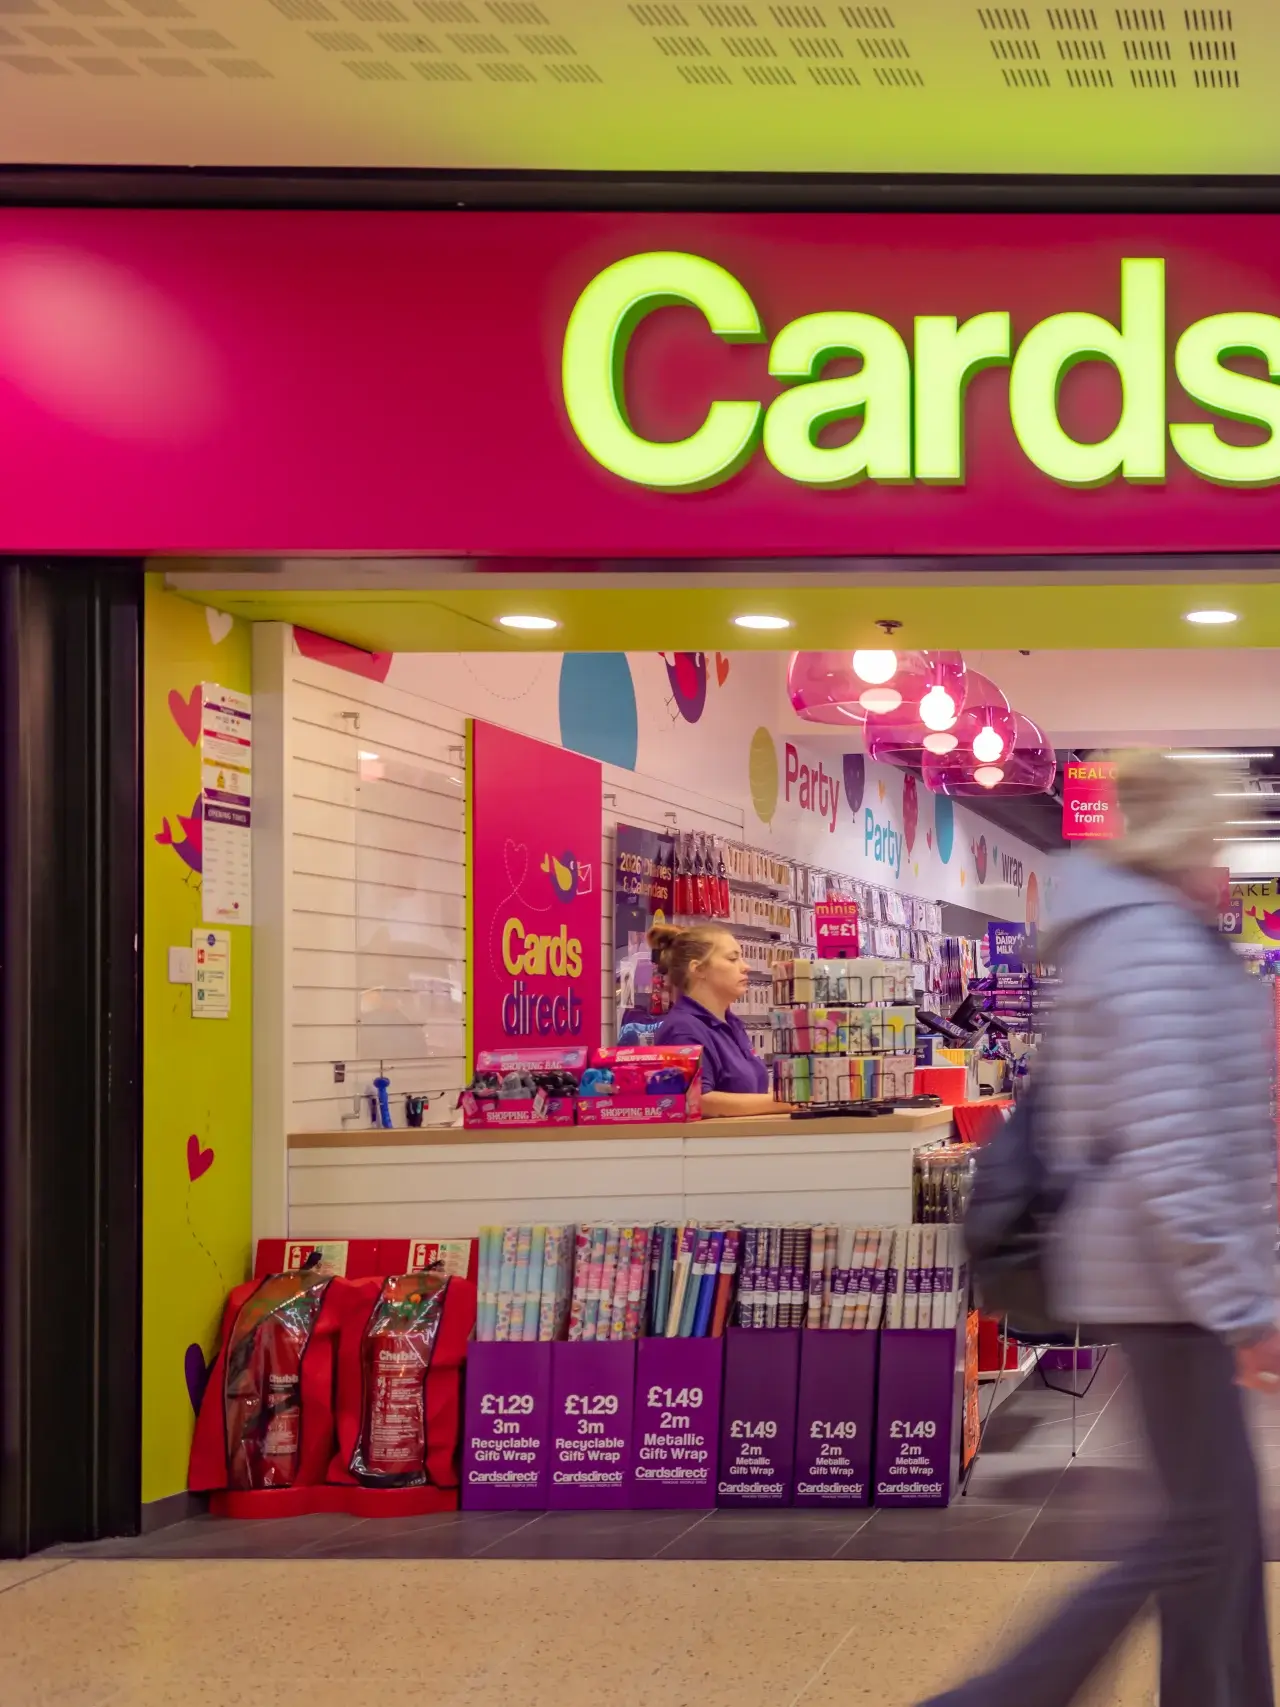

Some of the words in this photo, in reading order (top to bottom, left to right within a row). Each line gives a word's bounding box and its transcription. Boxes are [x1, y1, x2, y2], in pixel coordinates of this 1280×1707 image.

[1068, 767, 1106, 780] REAL
[785, 742, 840, 833] Party
[1070, 800, 1109, 811] Cards
[1074, 812, 1104, 823] from
[865, 807, 903, 880] Party
[620, 852, 641, 875] 2026
[1001, 853, 1023, 897] wrap
[1232, 884, 1270, 897] AKE
[816, 902, 857, 915] minis
[819, 924, 829, 937] 4
[840, 923, 857, 937] £1
[995, 935, 1017, 945] DAIRY
[502, 917, 583, 978] Cards
[996, 945, 1014, 955] MILK
[502, 979, 582, 1036] direct
[487, 1111, 530, 1120] SHOPPING
[600, 1108, 642, 1118] SHOPPING
[644, 1107, 662, 1117] BAG
[379, 1350, 418, 1361] Chubb
[269, 1374, 299, 1384] Chubb
[647, 1386, 703, 1408] £1.49
[481, 1394, 534, 1415] £1.29
[564, 1394, 618, 1415] £1.29
[493, 1419, 520, 1434] 3m
[577, 1419, 604, 1434] 3m
[660, 1412, 690, 1429] 2m
[730, 1420, 777, 1438] £1.49
[810, 1420, 857, 1439] £1.49
[889, 1420, 936, 1439] £1.49
[471, 1438, 540, 1451] Recyclable
[555, 1438, 624, 1451] Recyclable
[643, 1433, 704, 1446] Metallic
[639, 1448, 668, 1460] Gift
[671, 1448, 708, 1462] Wrap
[740, 1443, 762, 1455] 2m
[820, 1444, 842, 1456] 2m
[900, 1443, 922, 1455] 2m
[475, 1450, 500, 1461] Gift
[503, 1451, 536, 1463] Wrap
[559, 1450, 584, 1461] Gift
[587, 1451, 620, 1463] Wrap
[735, 1457, 771, 1466] Metallic
[815, 1457, 850, 1466] Metallic
[895, 1457, 930, 1466] Metallic
[468, 1470, 539, 1483] Cardsdirect
[553, 1471, 623, 1483] Cardsdirect
[635, 1466, 708, 1479] Cardsdirect
[729, 1466, 748, 1475] Gift
[749, 1467, 774, 1476] Wrap
[809, 1467, 828, 1475] Gift
[829, 1467, 854, 1477] Wrap
[889, 1466, 907, 1475] Gift
[909, 1467, 934, 1476] Wrap
[718, 1482, 783, 1493] Cardsdirect
[797, 1482, 862, 1493] Cardsdirect
[878, 1482, 942, 1493] Cardsdirect
